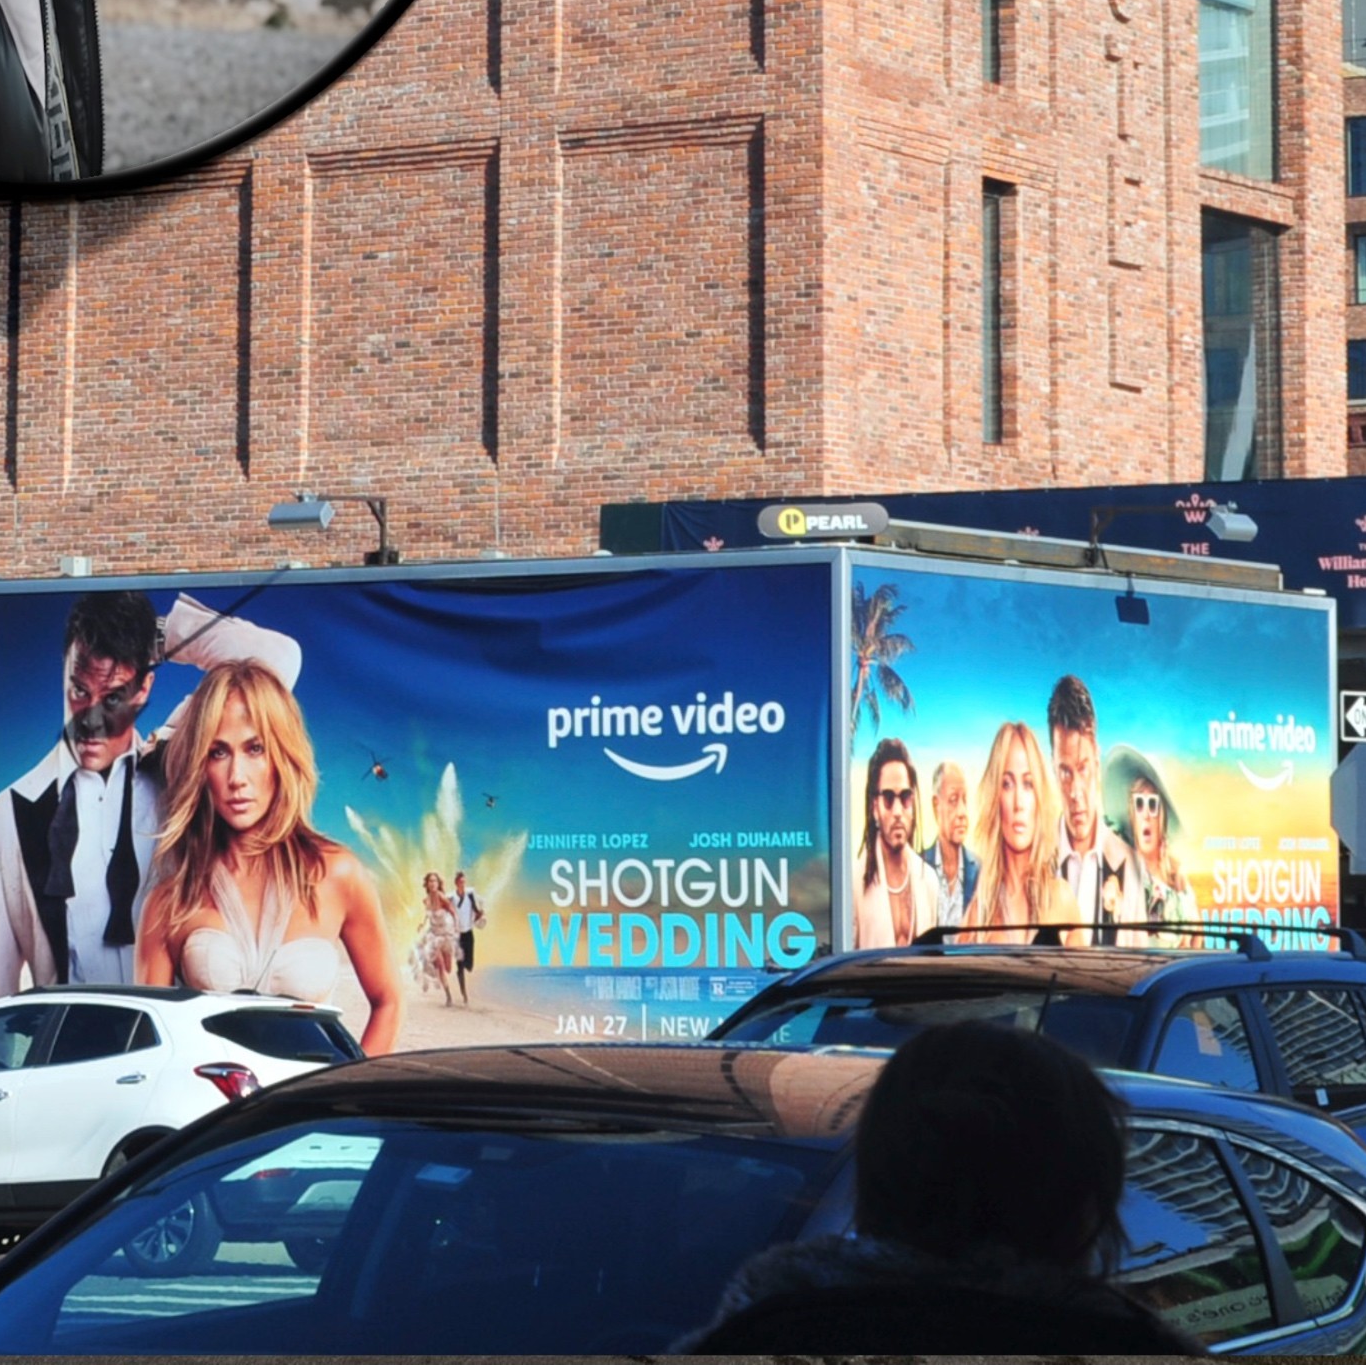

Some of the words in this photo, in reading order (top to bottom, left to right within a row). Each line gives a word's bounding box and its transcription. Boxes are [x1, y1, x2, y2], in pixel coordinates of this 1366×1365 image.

[806, 515, 868, 530] PEARL
[1181, 543, 1210, 555] THE
[548, 695, 662, 747] prime
[671, 691, 785, 734] video
[1209, 711, 1266, 757] prime
[1267, 714, 1316, 753] video
[528, 834, 596, 849] JENNIFER
[602, 833, 649, 849] LOPEZ
[689, 832, 731, 848] JOSH
[737, 831, 812, 848] DUHAMEL
[550, 857, 788, 908] SHOTGUN
[1212, 859, 1322, 904] SHOTGUN
[527, 911, 817, 969] WEDDING
[1201, 905, 1331, 951] WEDDING
[554, 1015, 595, 1035] JAN
[602, 1014, 627, 1035] 27
[660, 1016, 710, 1037] NEW
